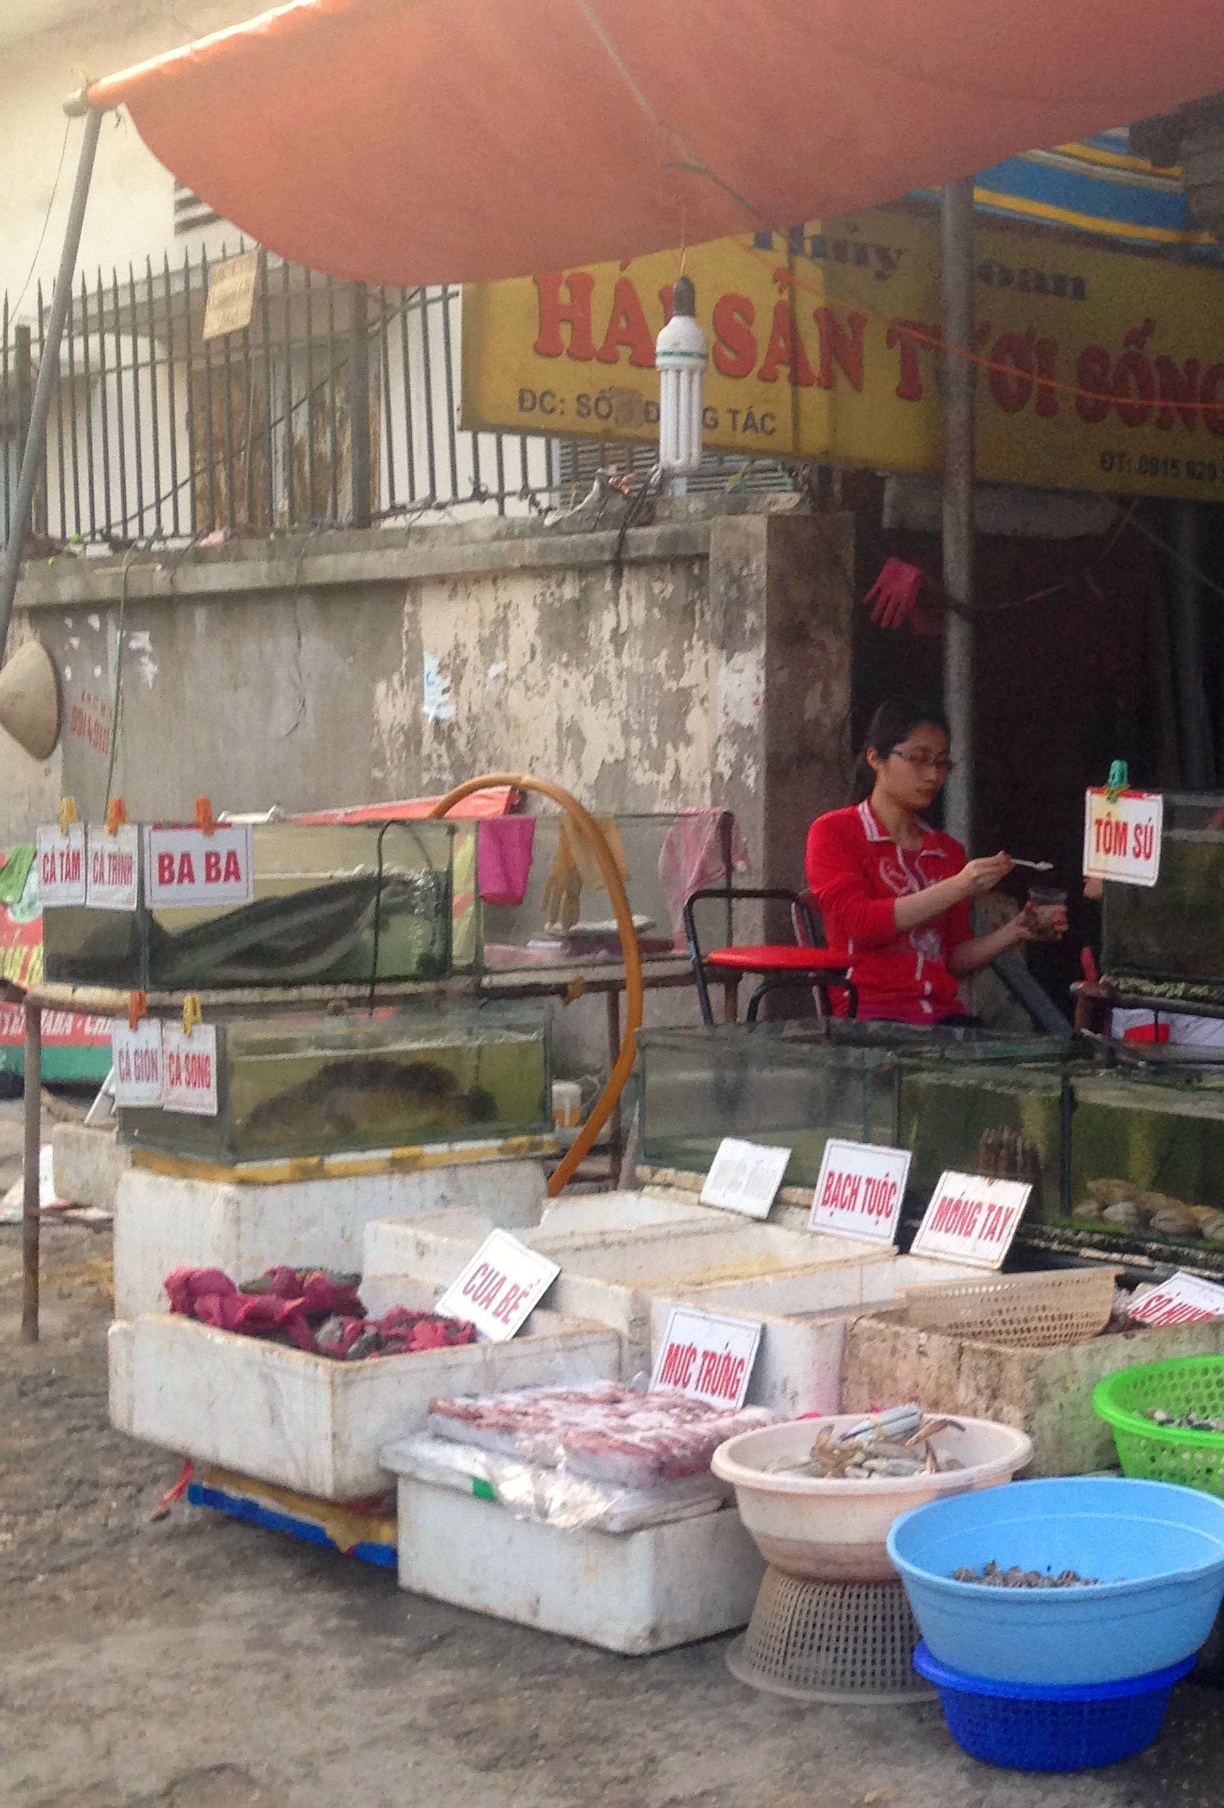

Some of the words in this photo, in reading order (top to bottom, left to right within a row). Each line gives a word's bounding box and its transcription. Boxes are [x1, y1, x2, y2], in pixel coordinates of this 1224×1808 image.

[712, 267, 868, 394] SẢN
[727, 405, 778, 437] TÁC
[1095, 811, 1128, 857] TÔM
[1132, 816, 1154, 861] SÚ
[157, 852, 196, 887] BA
[204, 850, 242, 884] BA
[977, 1202, 1016, 1244] TAY
[462, 1261, 508, 1311] CUA
